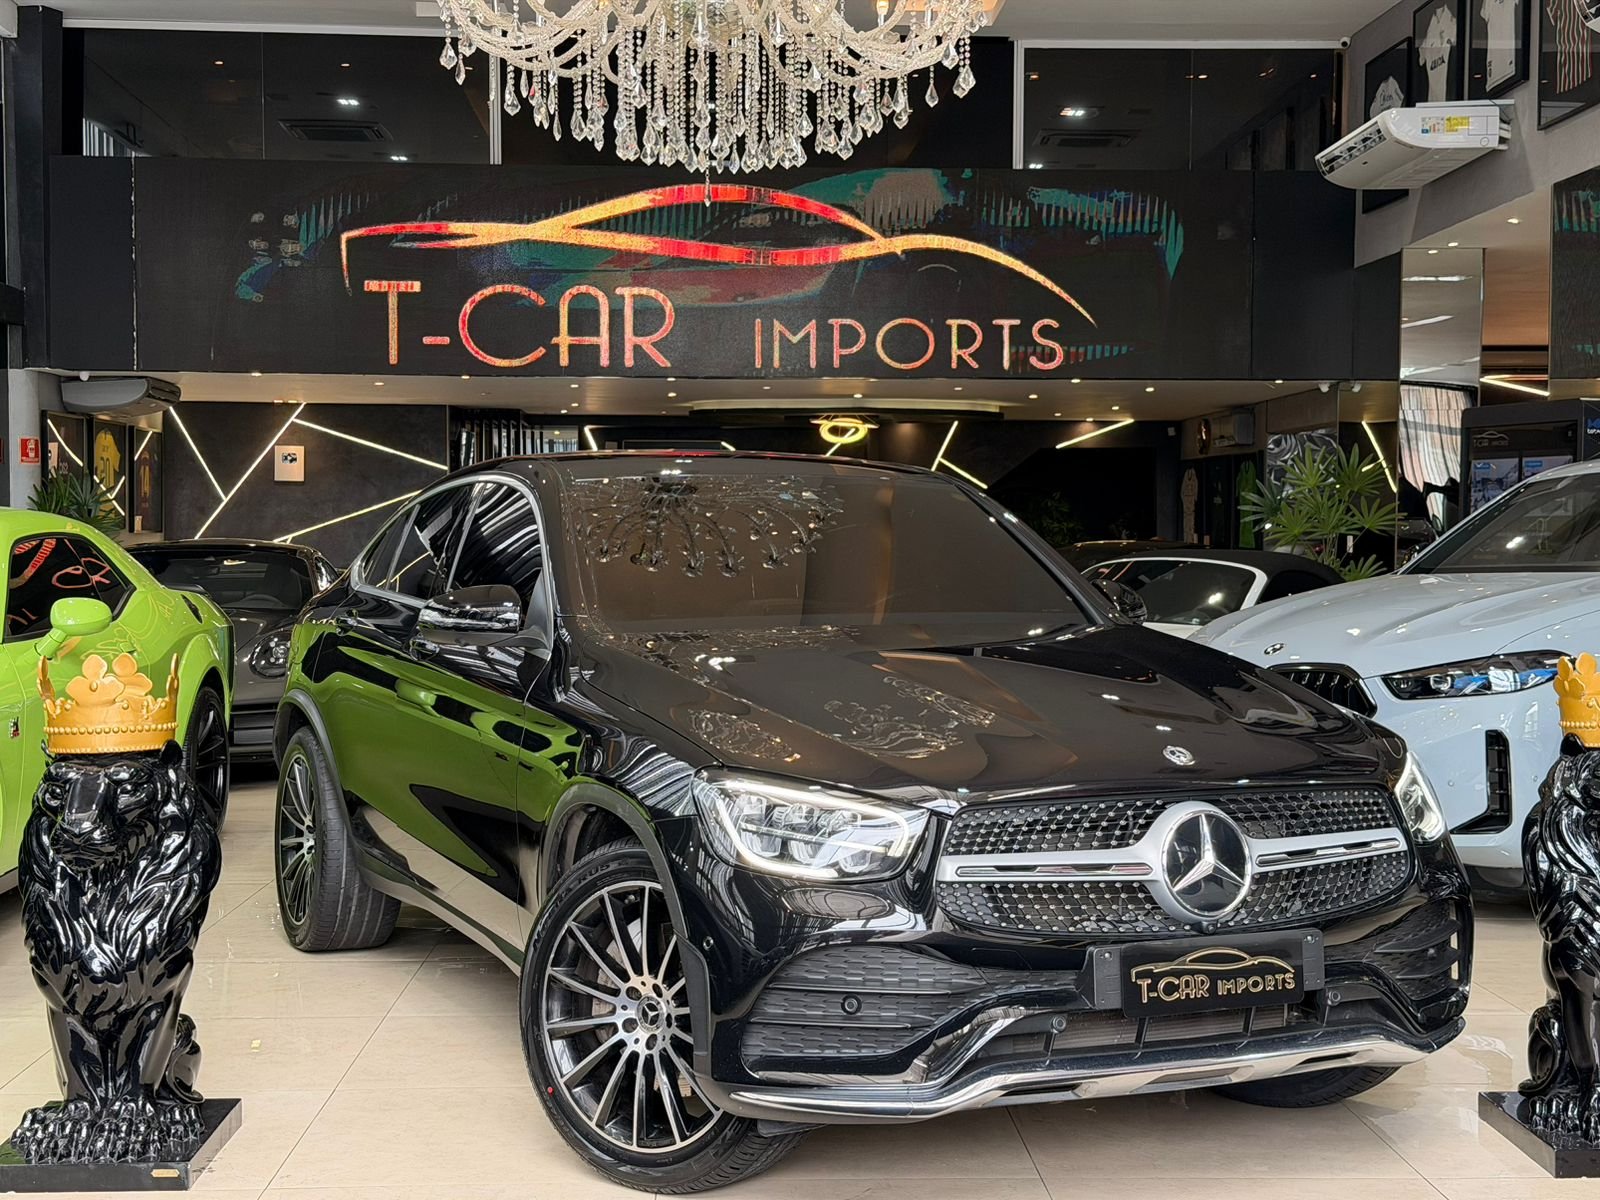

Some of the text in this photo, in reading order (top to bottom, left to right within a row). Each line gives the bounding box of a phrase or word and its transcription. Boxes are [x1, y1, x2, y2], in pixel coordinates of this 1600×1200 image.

[364, 280, 1065, 370] T-CAR IMPORTS
[1137, 972, 1295, 1003] T-CAR IMPORTS
